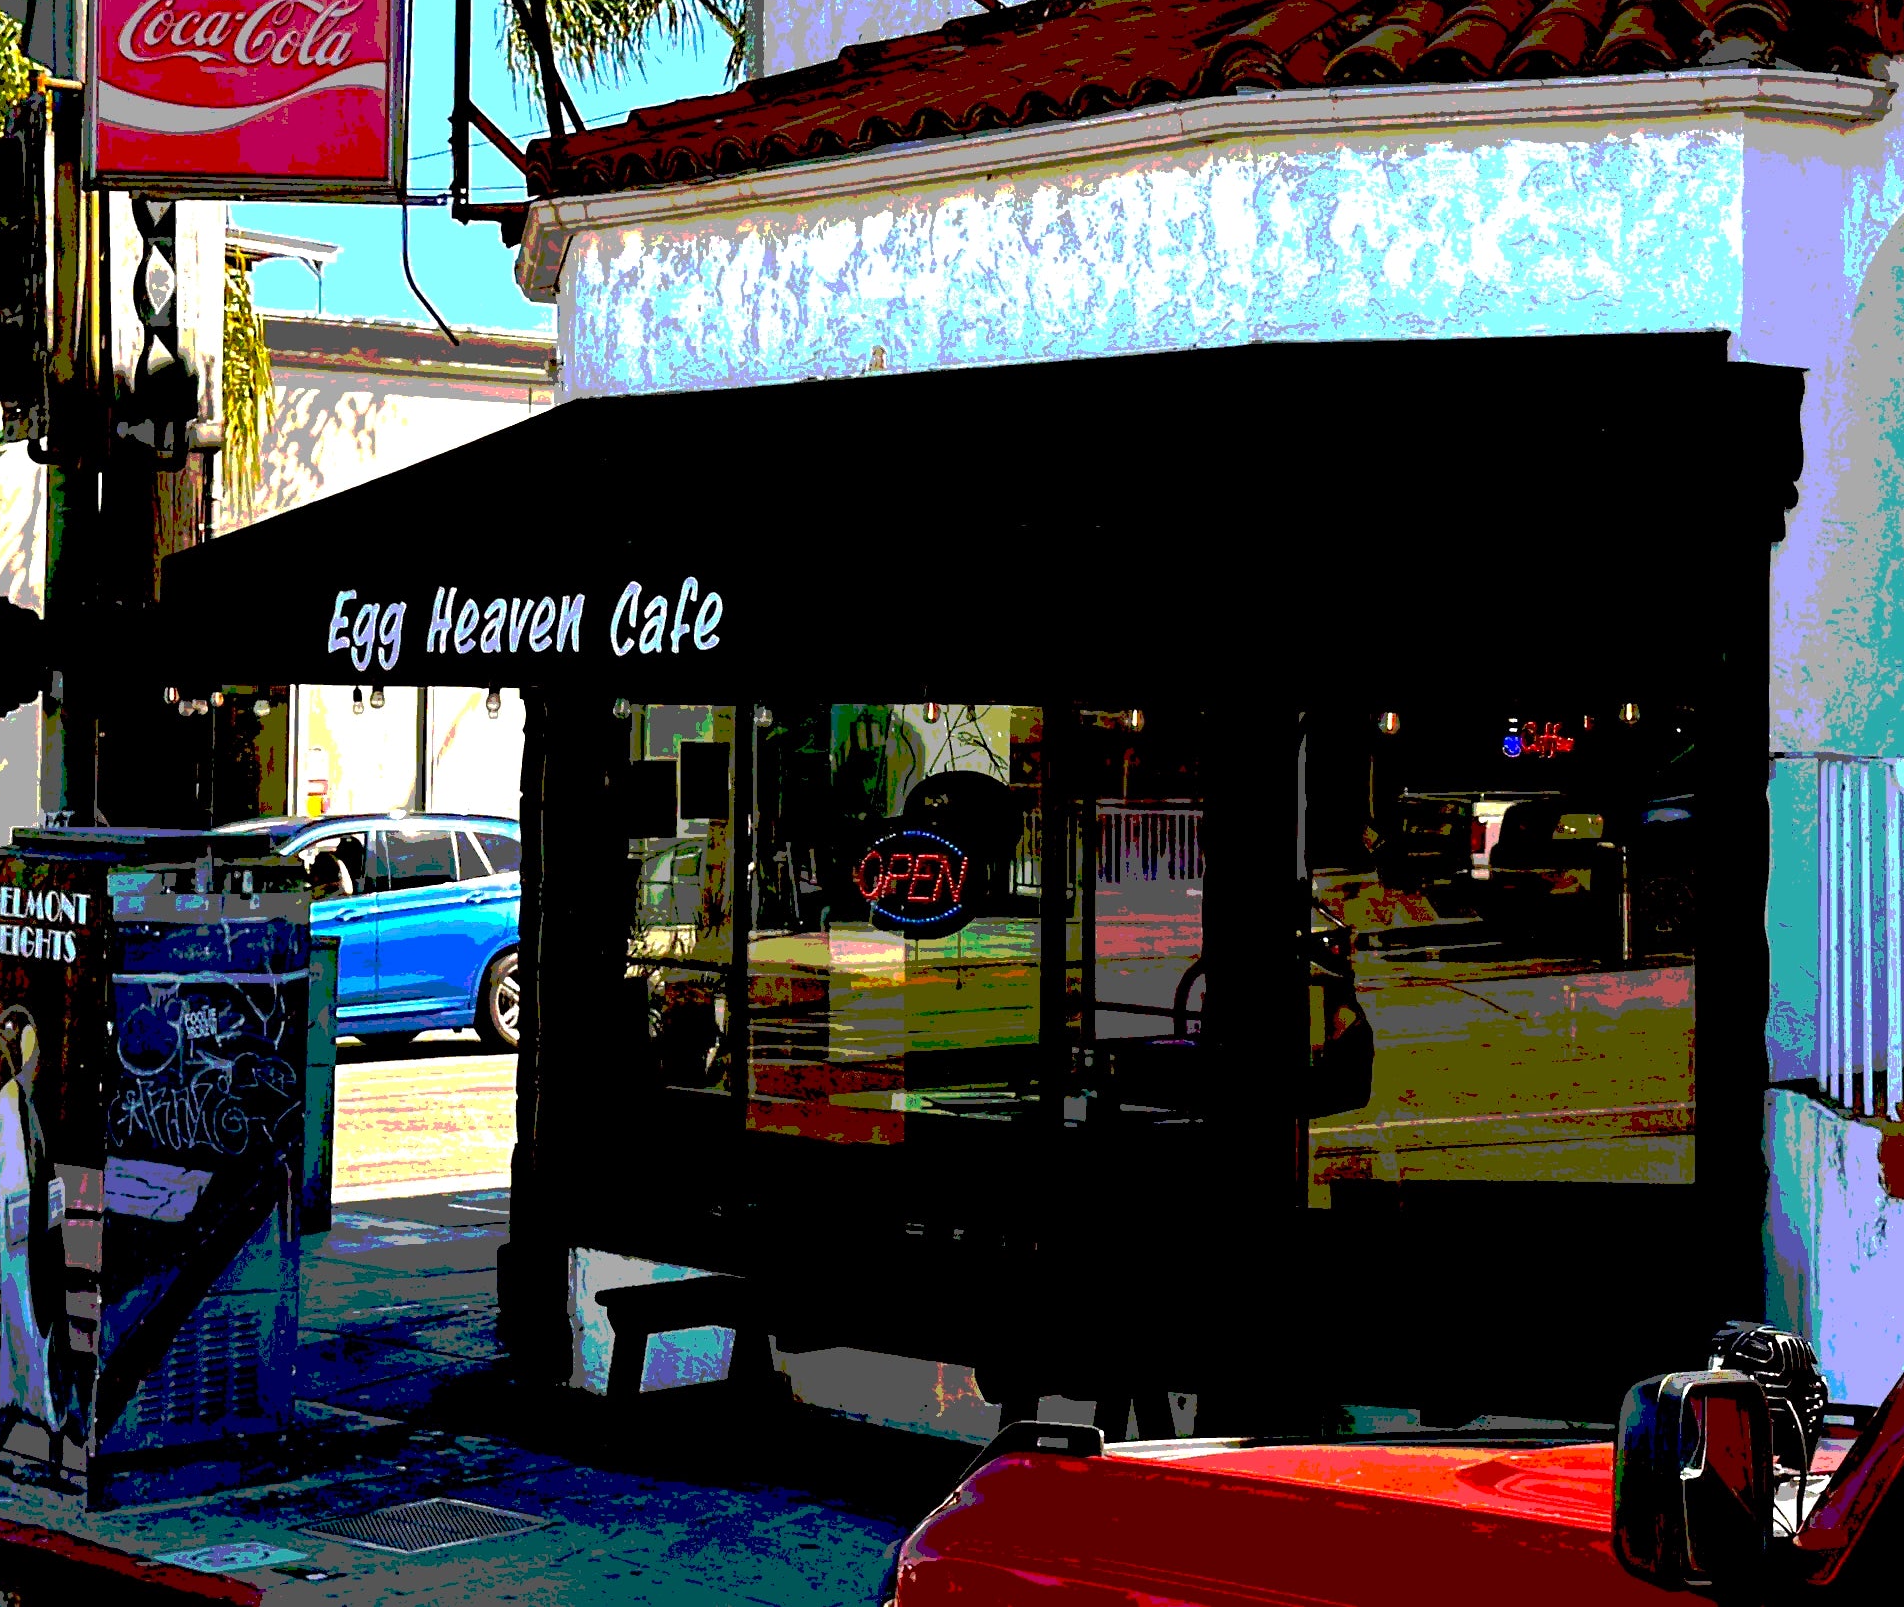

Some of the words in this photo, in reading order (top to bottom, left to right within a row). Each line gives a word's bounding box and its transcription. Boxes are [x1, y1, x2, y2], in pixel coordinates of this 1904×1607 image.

[327, 589, 408, 671] Egg
[426, 586, 586, 654] Heaven
[609, 576, 724, 656] Cafe
[859, 850, 969, 903] OPEN
